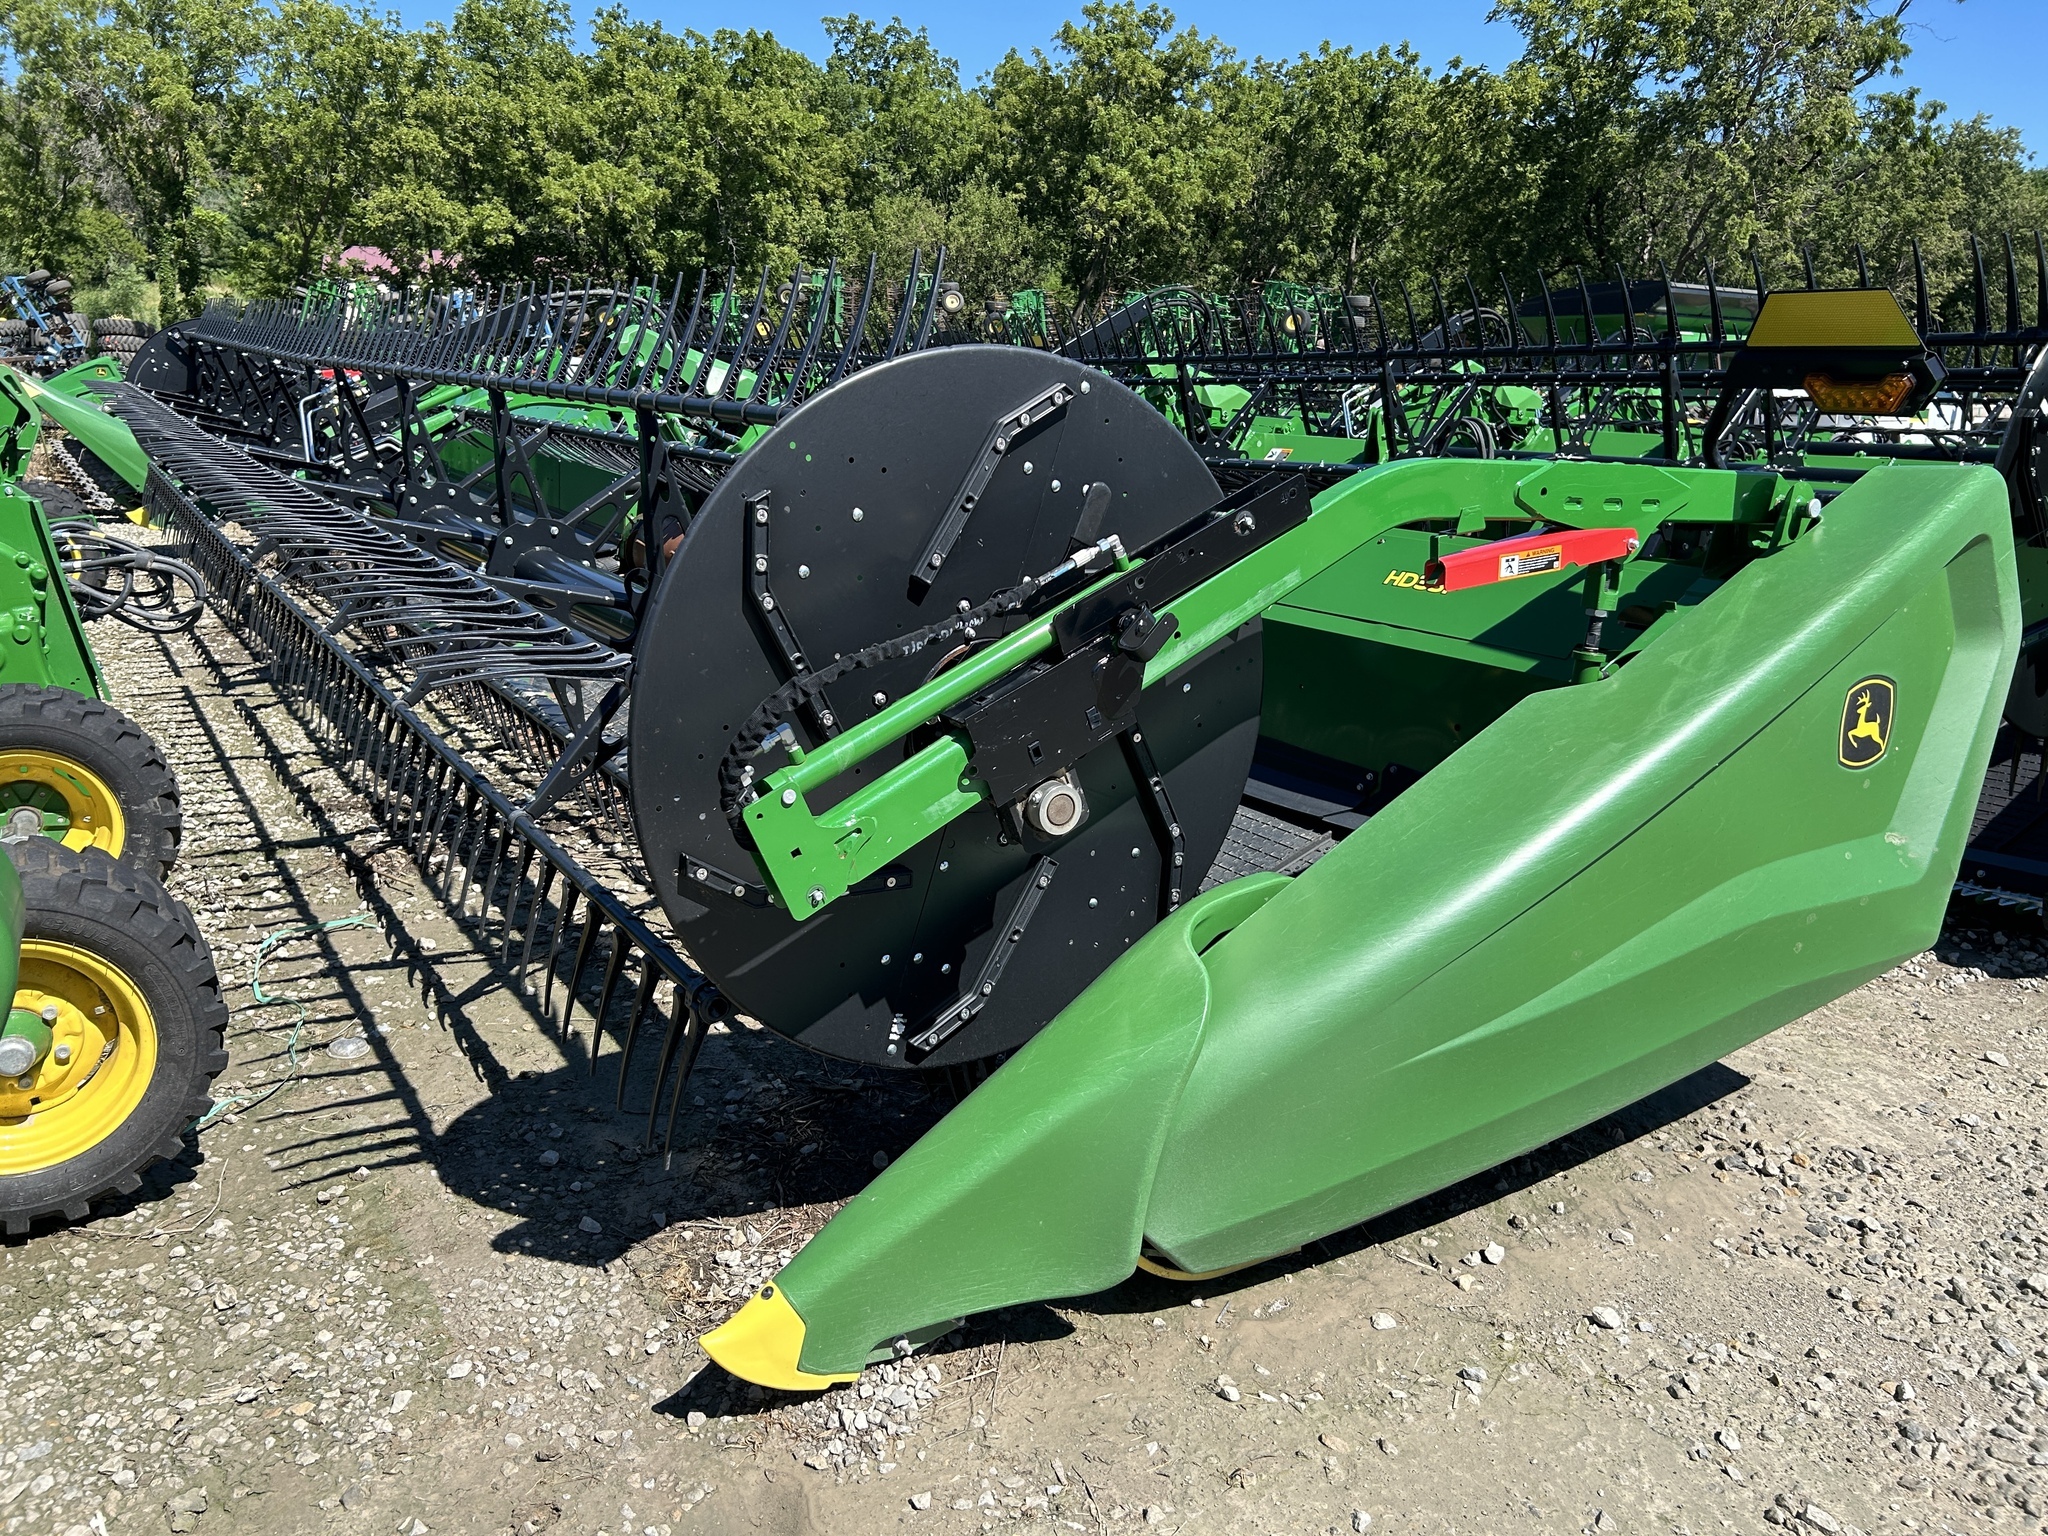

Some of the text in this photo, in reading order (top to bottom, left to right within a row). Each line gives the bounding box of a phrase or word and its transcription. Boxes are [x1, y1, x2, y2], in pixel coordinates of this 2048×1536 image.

[1532, 547, 1555, 556] WARNING
[1383, 569, 1448, 595] HD3
[40, 917, 133, 952] CHIEF
